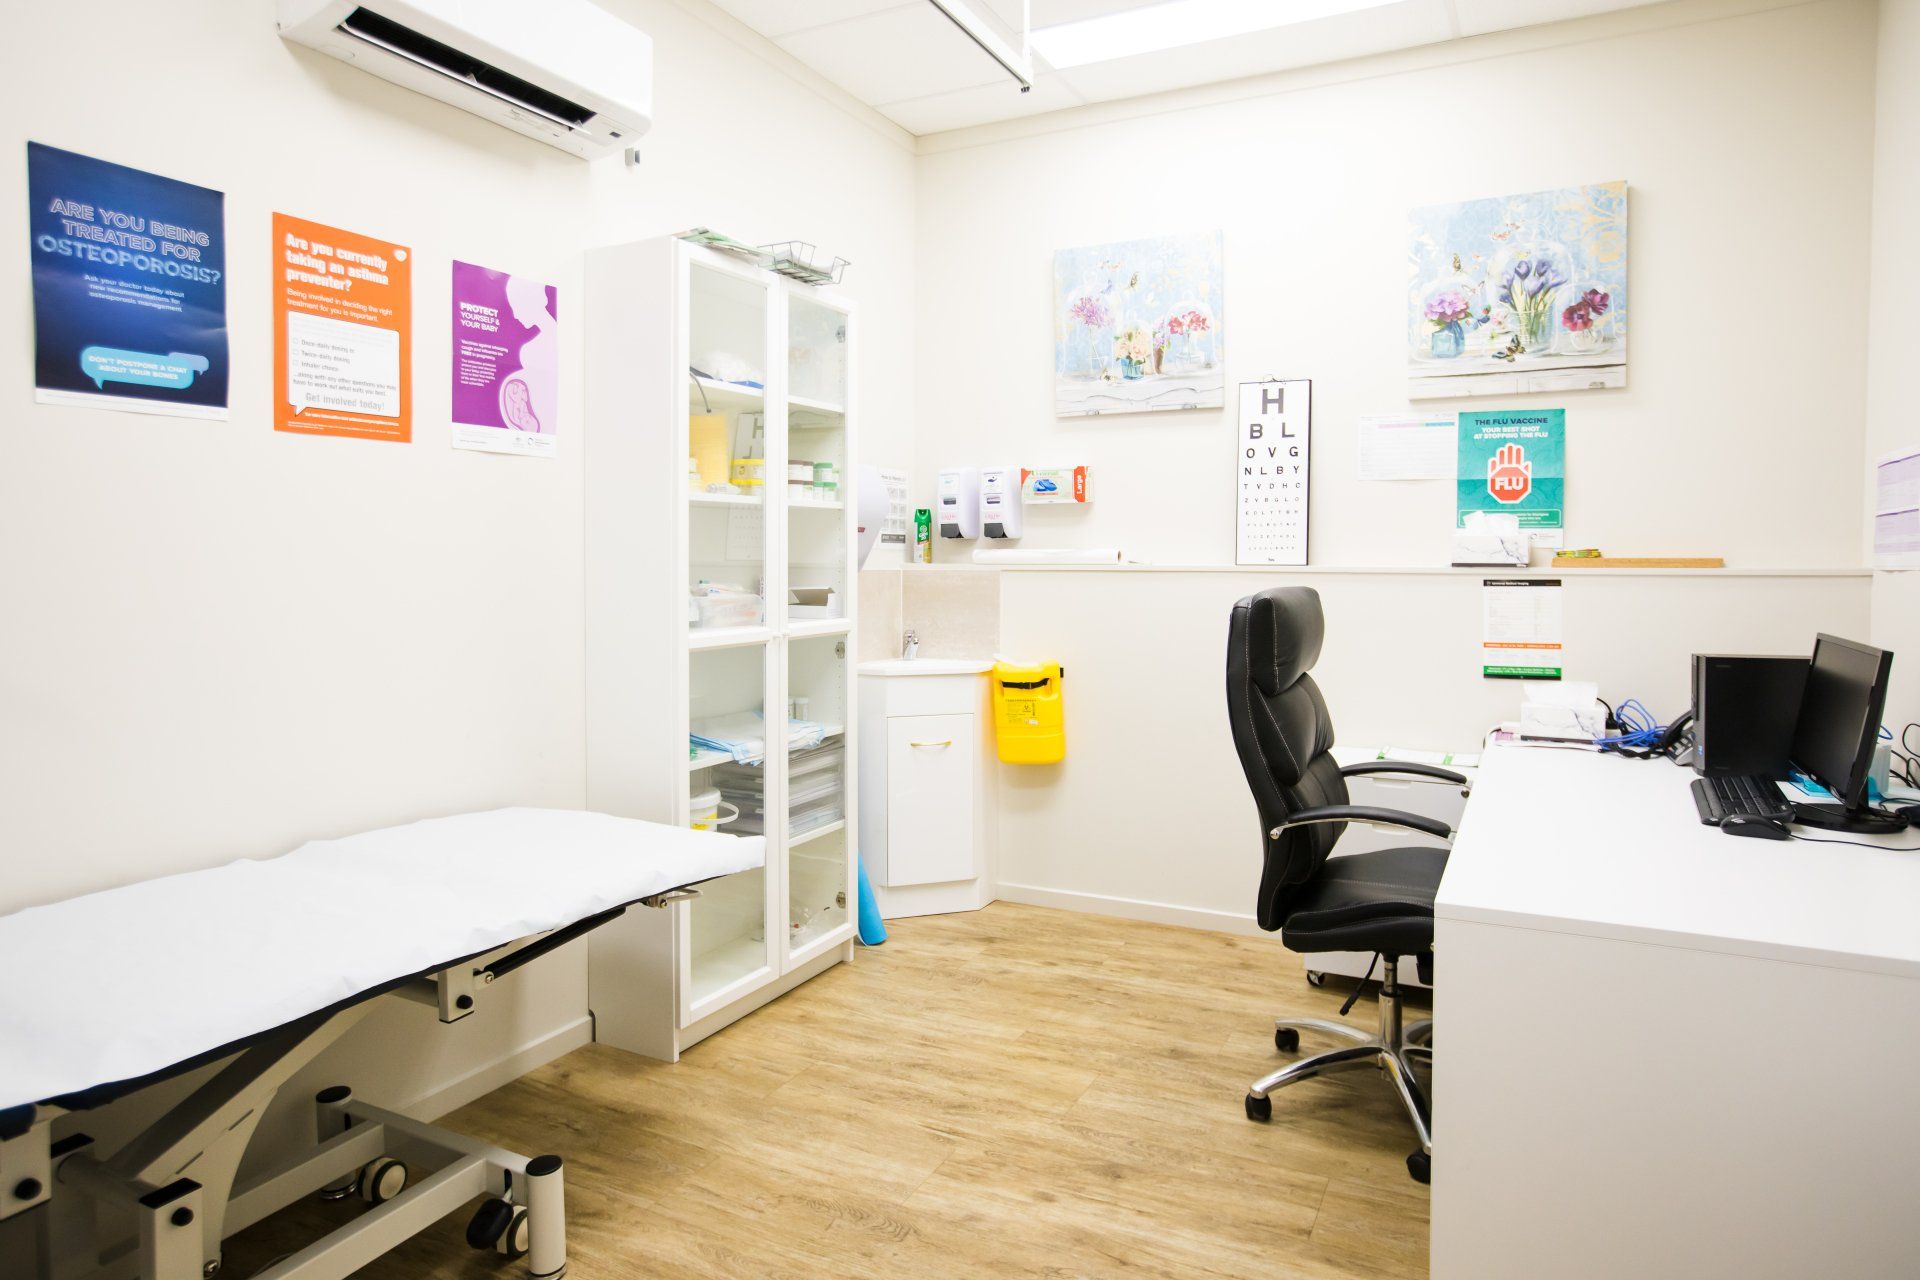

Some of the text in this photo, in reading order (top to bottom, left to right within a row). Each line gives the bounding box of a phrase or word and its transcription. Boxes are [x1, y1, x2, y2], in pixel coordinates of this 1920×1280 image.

[50, 198, 210, 247] ARE YOU BEING
[62, 219, 201, 263] TREATED FOR
[38, 234, 221, 284] OSTEOPOROSIS?
[286, 233, 387, 272] Are you currently
[286, 249, 389, 285] taking an asthma
[84, 274, 185, 298] Ask your doctor today about
[286, 269, 352, 292] preventer?
[287, 288, 307, 300] Being
[342, 299, 367, 312] deciding
[368, 305, 378, 313] the
[379, 308, 392, 316] right
[287, 298, 319, 310] treatment
[319, 304, 329, 312] for
[330, 307, 341, 315] you
[460, 302, 499, 317] PROTECT
[460, 311, 495, 324] YOURSELF
[460, 319, 499, 333] YOUR BABY
[99, 365, 127, 373] ABOUT
[129, 368, 151, 376] YOUR
[117, 359, 158, 370] POSTPONE
[167, 365, 188, 373] CHAT
[305, 393, 385, 411] Get involved today!
[1261, 388, 1284, 414] H
[1249, 422, 1296, 439] B L
[1246, 446, 1299, 459] O V G
[1244, 465, 1300, 476] N L B Y
[1076, 475, 1084, 494] Large
[1495, 476, 1524, 490] FLU
